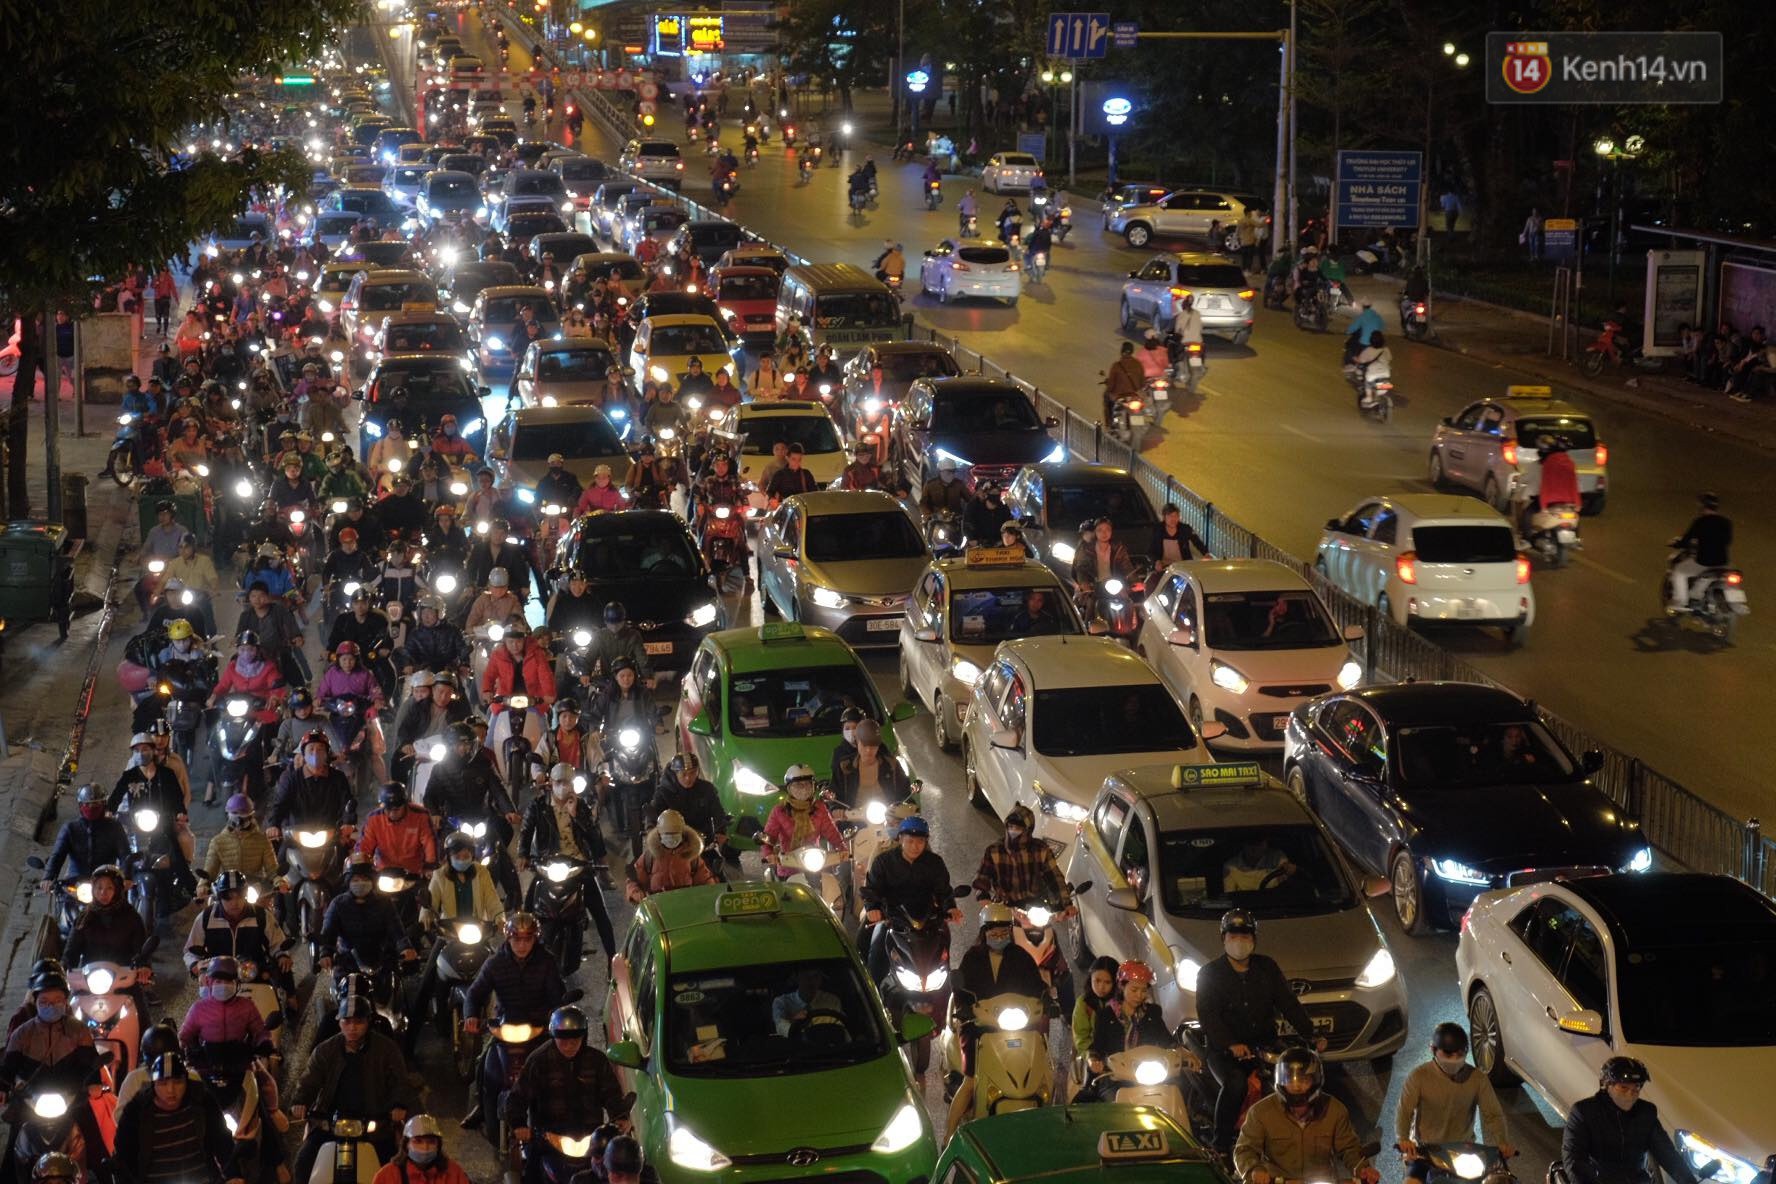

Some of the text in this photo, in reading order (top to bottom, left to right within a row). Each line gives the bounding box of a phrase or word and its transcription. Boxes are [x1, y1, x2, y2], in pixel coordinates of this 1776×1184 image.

[1350, 184, 1407, 195] NHÀ SÁCH
[1200, 765, 1257, 778] SAO MAI TAXI
[1108, 1133, 1160, 1151] TAXI
